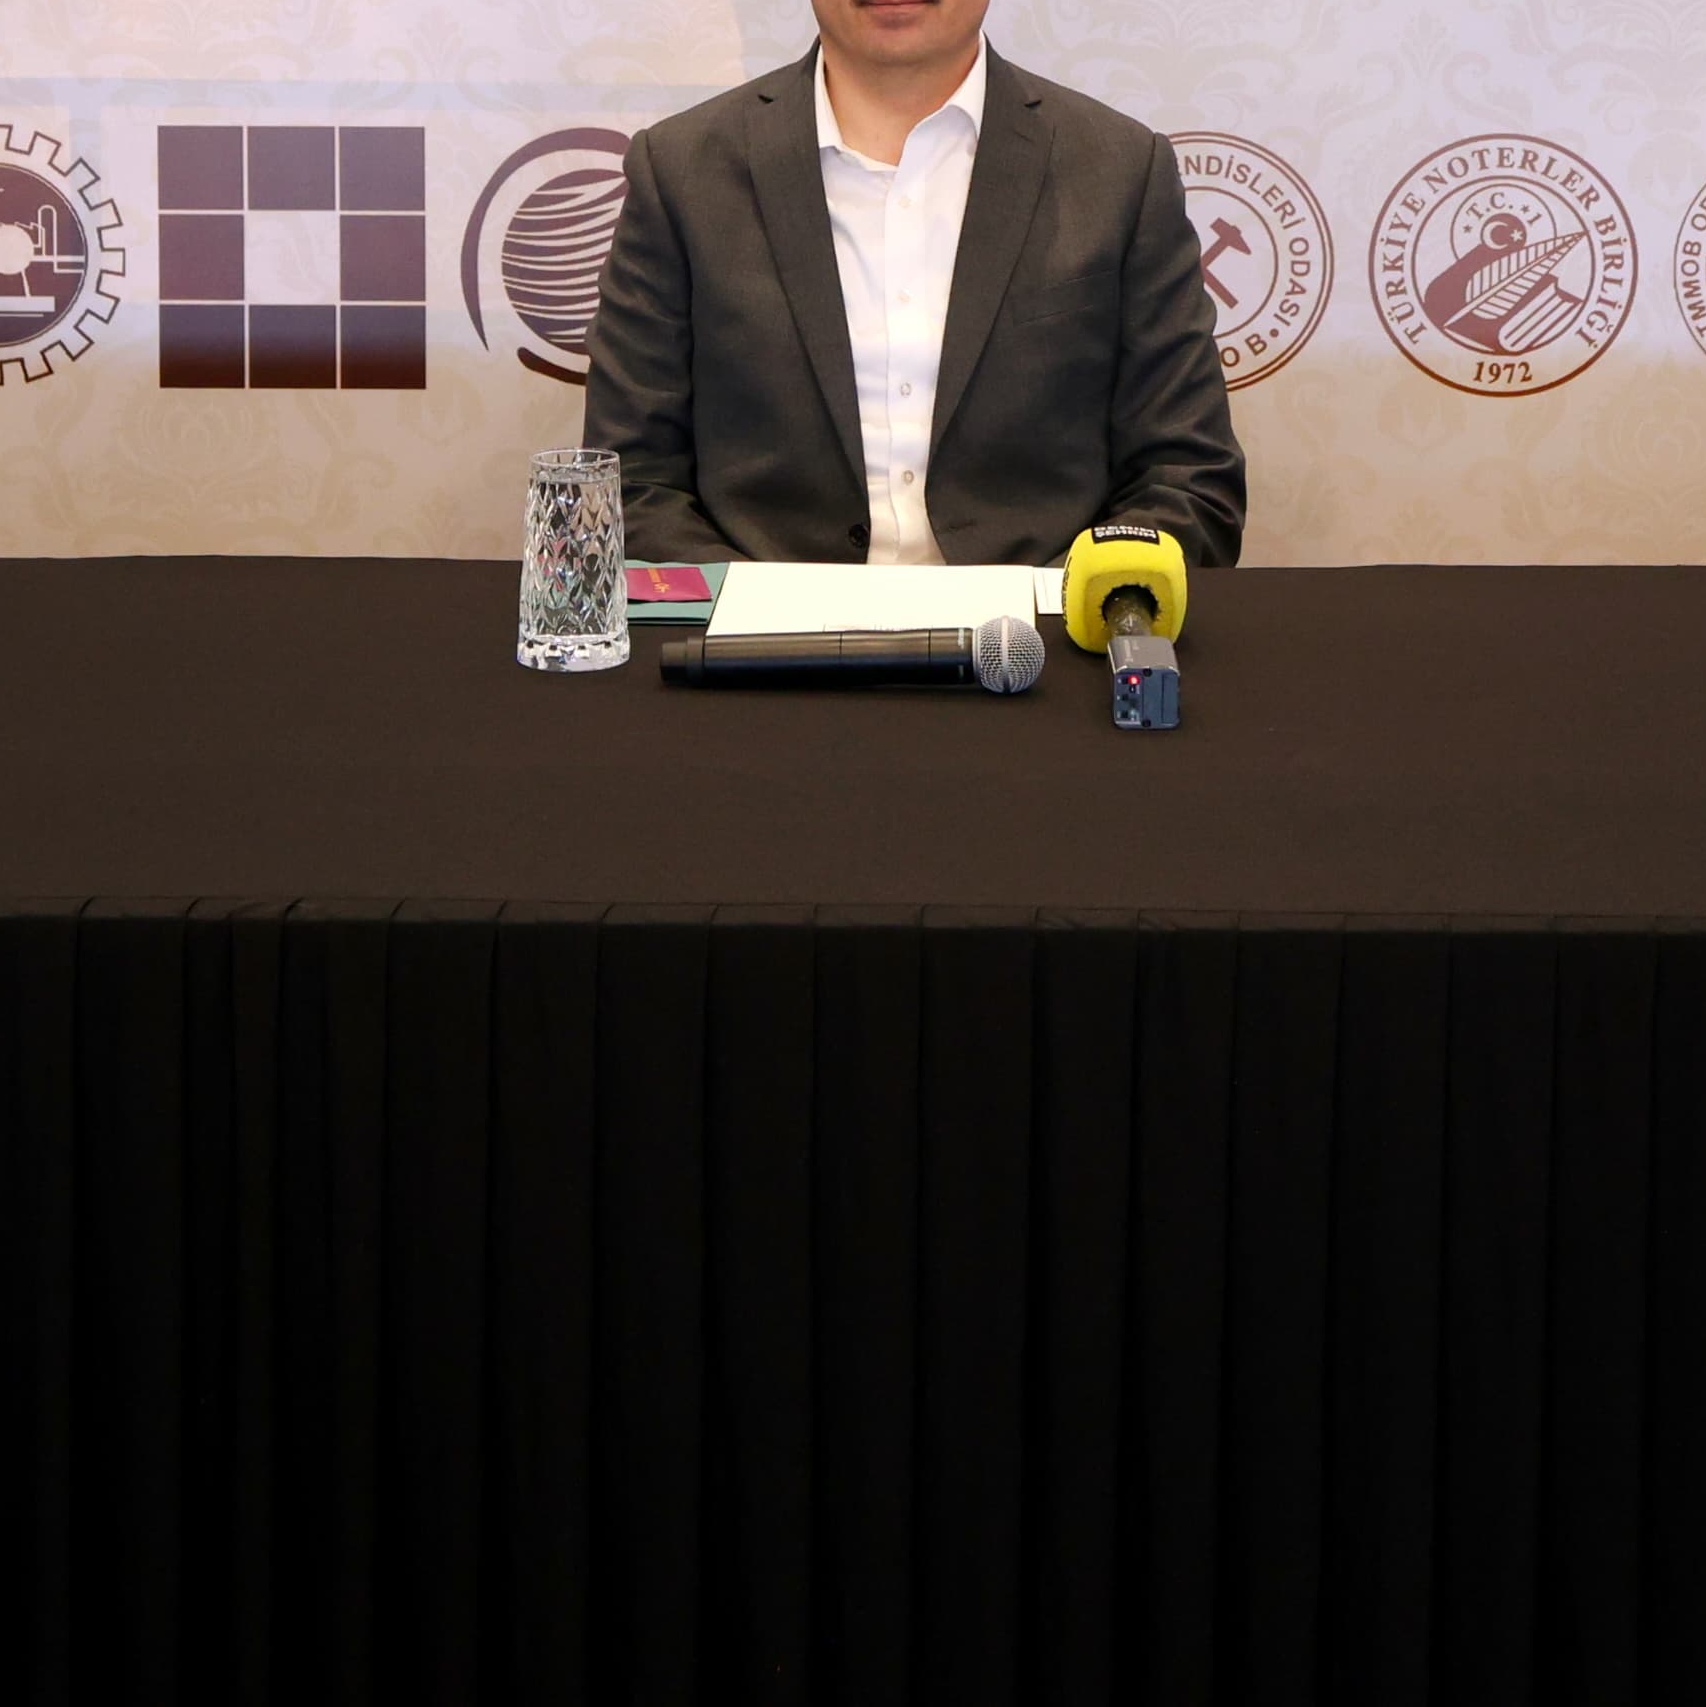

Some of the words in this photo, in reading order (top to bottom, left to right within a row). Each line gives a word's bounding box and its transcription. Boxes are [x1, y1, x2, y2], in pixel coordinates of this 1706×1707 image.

[1274, 237, 1311, 327] ODASI
[1380, 192, 1428, 345] TÜRKİYE
[1422, 147, 1601, 211] NOTERLER
[1575, 214, 1628, 349] BİRLİĞİ
[1472, 361, 1533, 385] 1972
